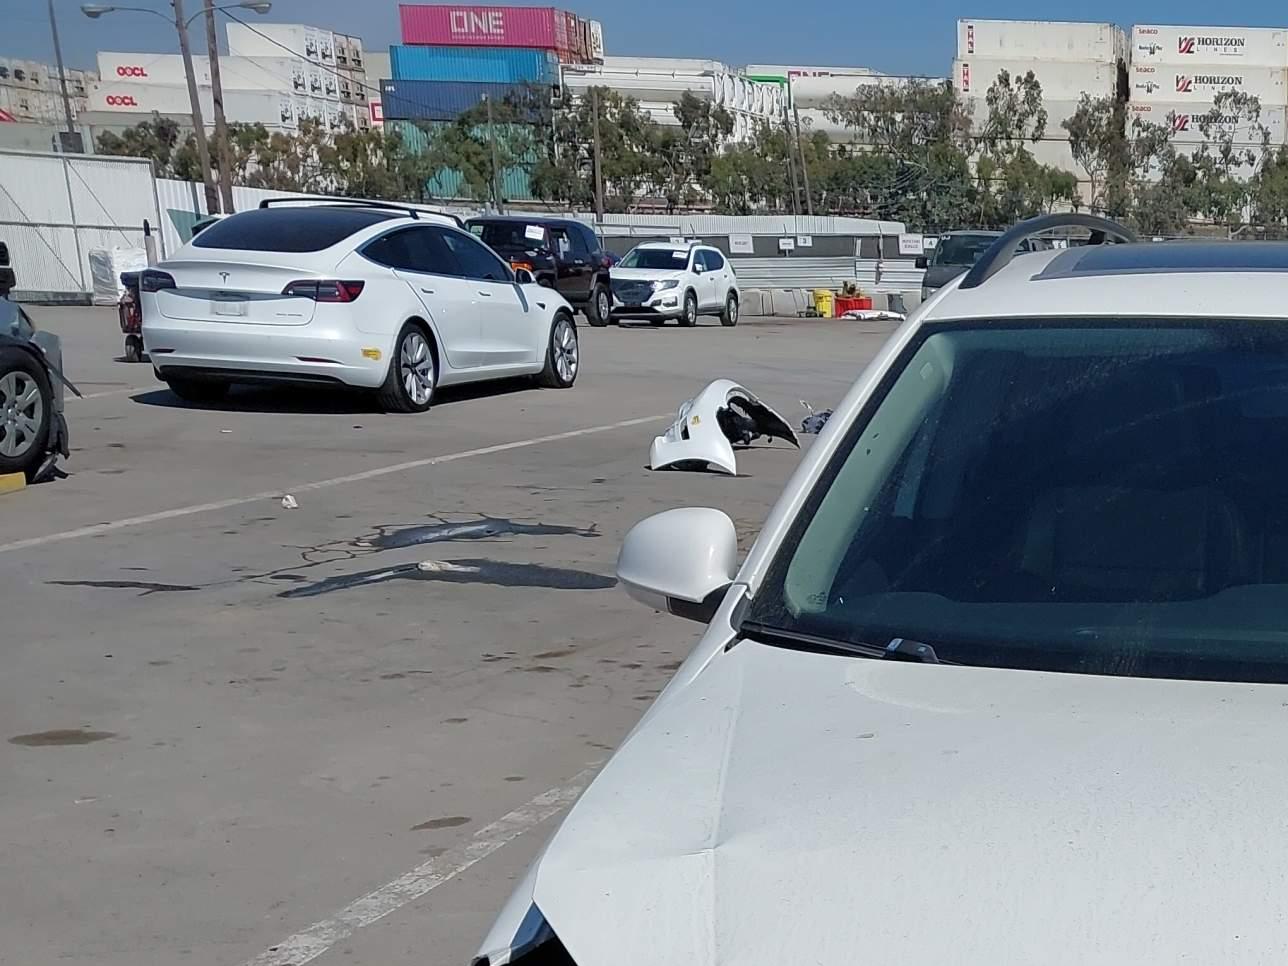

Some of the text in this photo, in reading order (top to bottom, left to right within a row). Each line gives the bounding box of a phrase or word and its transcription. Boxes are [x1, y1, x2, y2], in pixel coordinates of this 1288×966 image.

[450, 11, 504, 34] ONE
[1197, 37, 1246, 47] HORIZON
[116, 66, 148, 77] OOCL
[1194, 75, 1243, 85] HORIZON
[106, 95, 138, 106] OOCL
